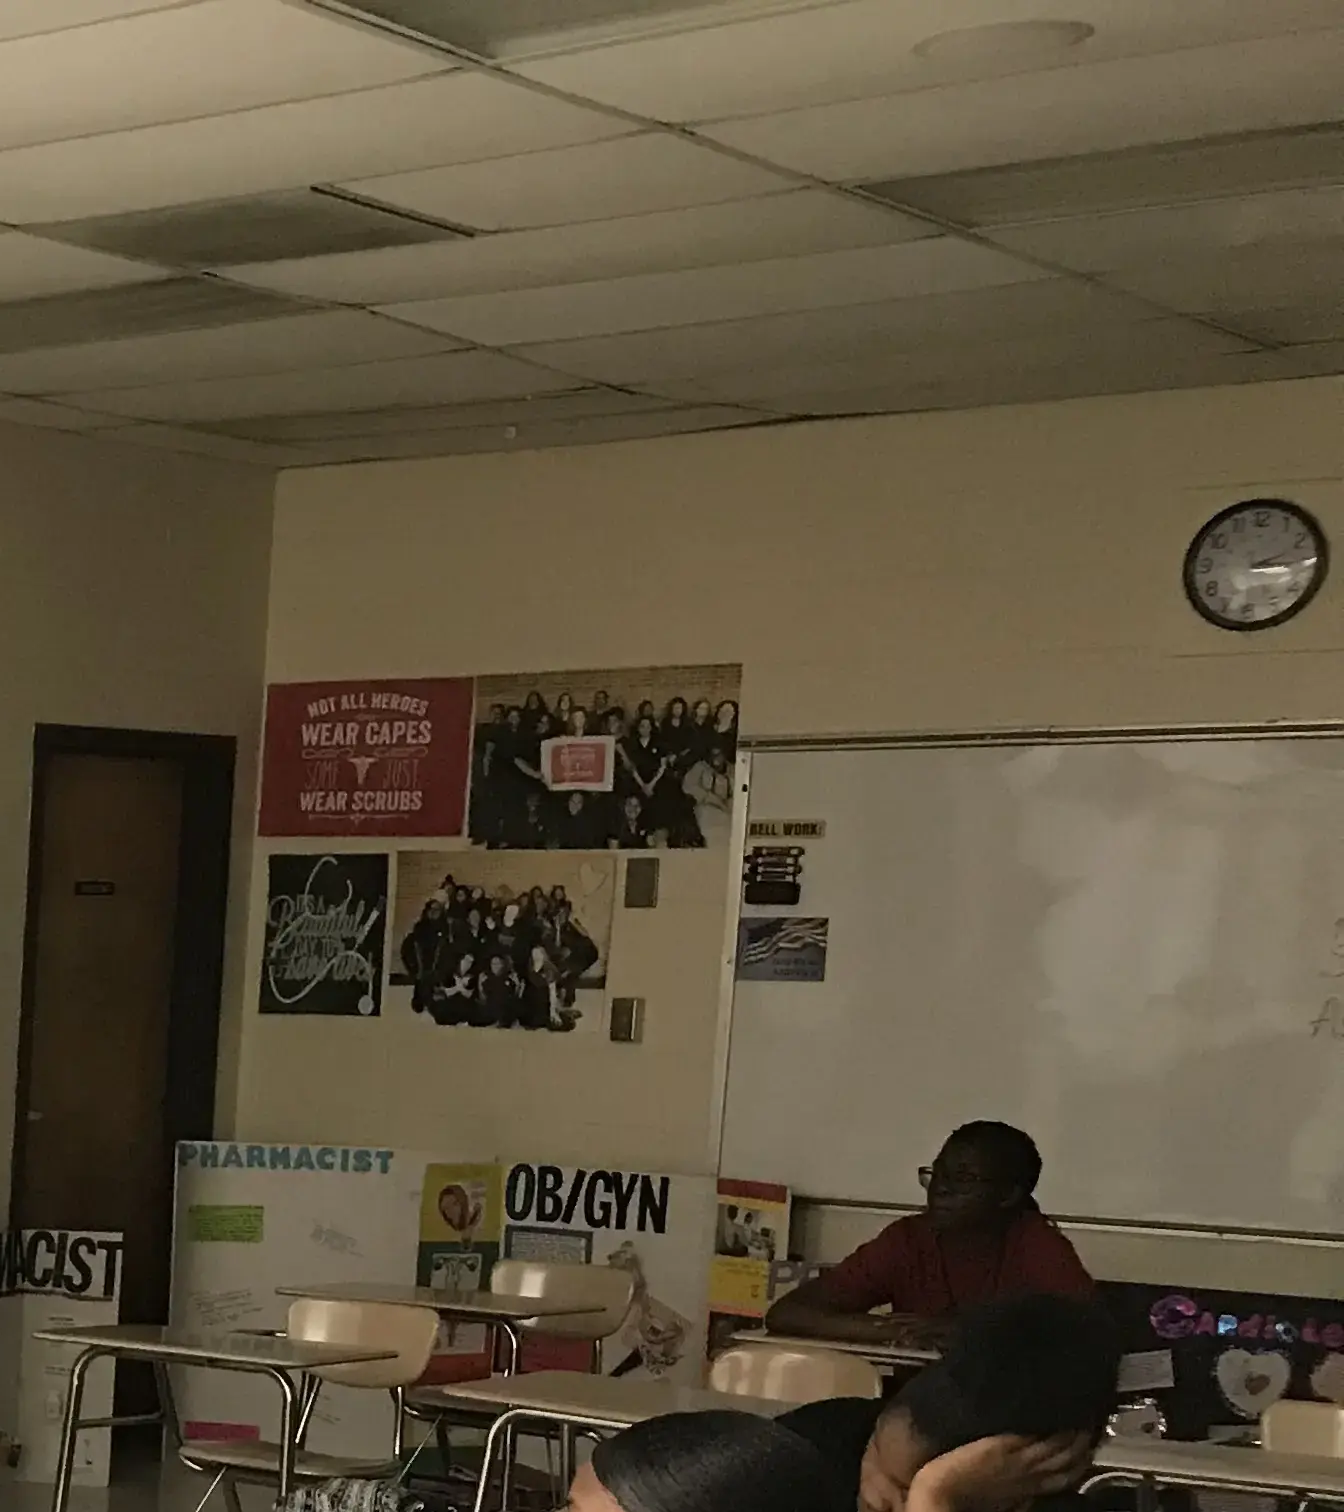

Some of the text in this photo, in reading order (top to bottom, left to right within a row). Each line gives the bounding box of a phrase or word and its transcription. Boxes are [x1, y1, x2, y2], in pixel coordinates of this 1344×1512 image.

[307, 692, 430, 719] NOT ALL HEROES
[301, 719, 432, 747] WEAR CAPES
[304, 757, 420, 790] SOME JUST
[299, 789, 423, 812] WEAR SCRUBS
[178, 1142, 394, 1174] PHARMACIST
[505, 1163, 670, 1234] OB/GYN
